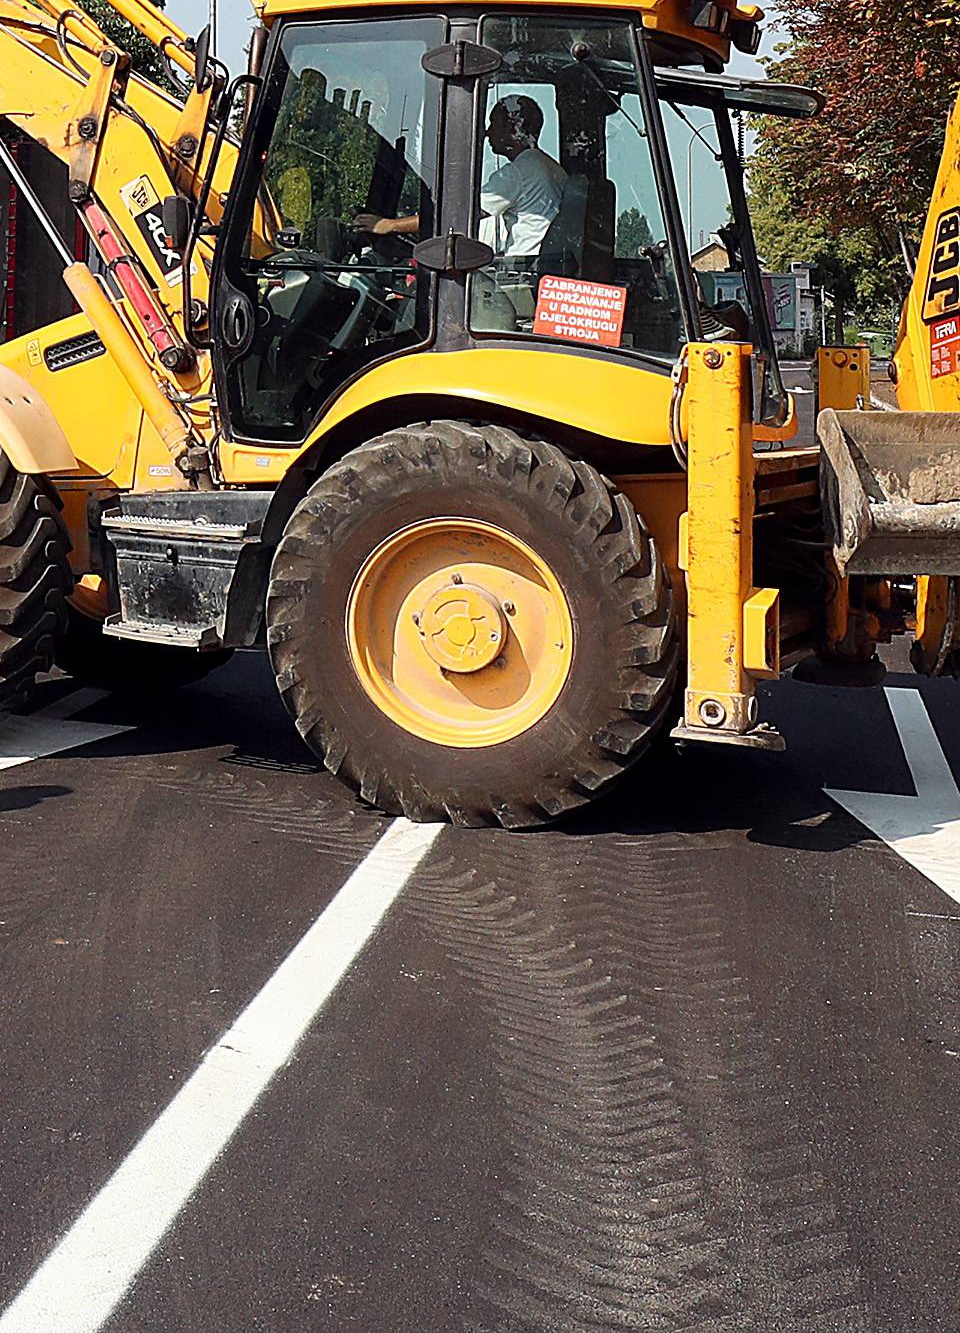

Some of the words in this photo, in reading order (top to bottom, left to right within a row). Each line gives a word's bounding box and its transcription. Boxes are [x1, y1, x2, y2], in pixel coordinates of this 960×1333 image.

[131, 185, 149, 208] JCB
[145, 212, 181, 267] 4CX
[544, 278, 621, 299] ZABRANJENO
[540, 289, 623, 311] ZADRŽAVANJE
[549, 301, 559, 311] U
[560, 303, 611, 320] RADNOM
[539, 311, 618, 332] DJELOKRUGU
[553, 325, 600, 341] STROJA
